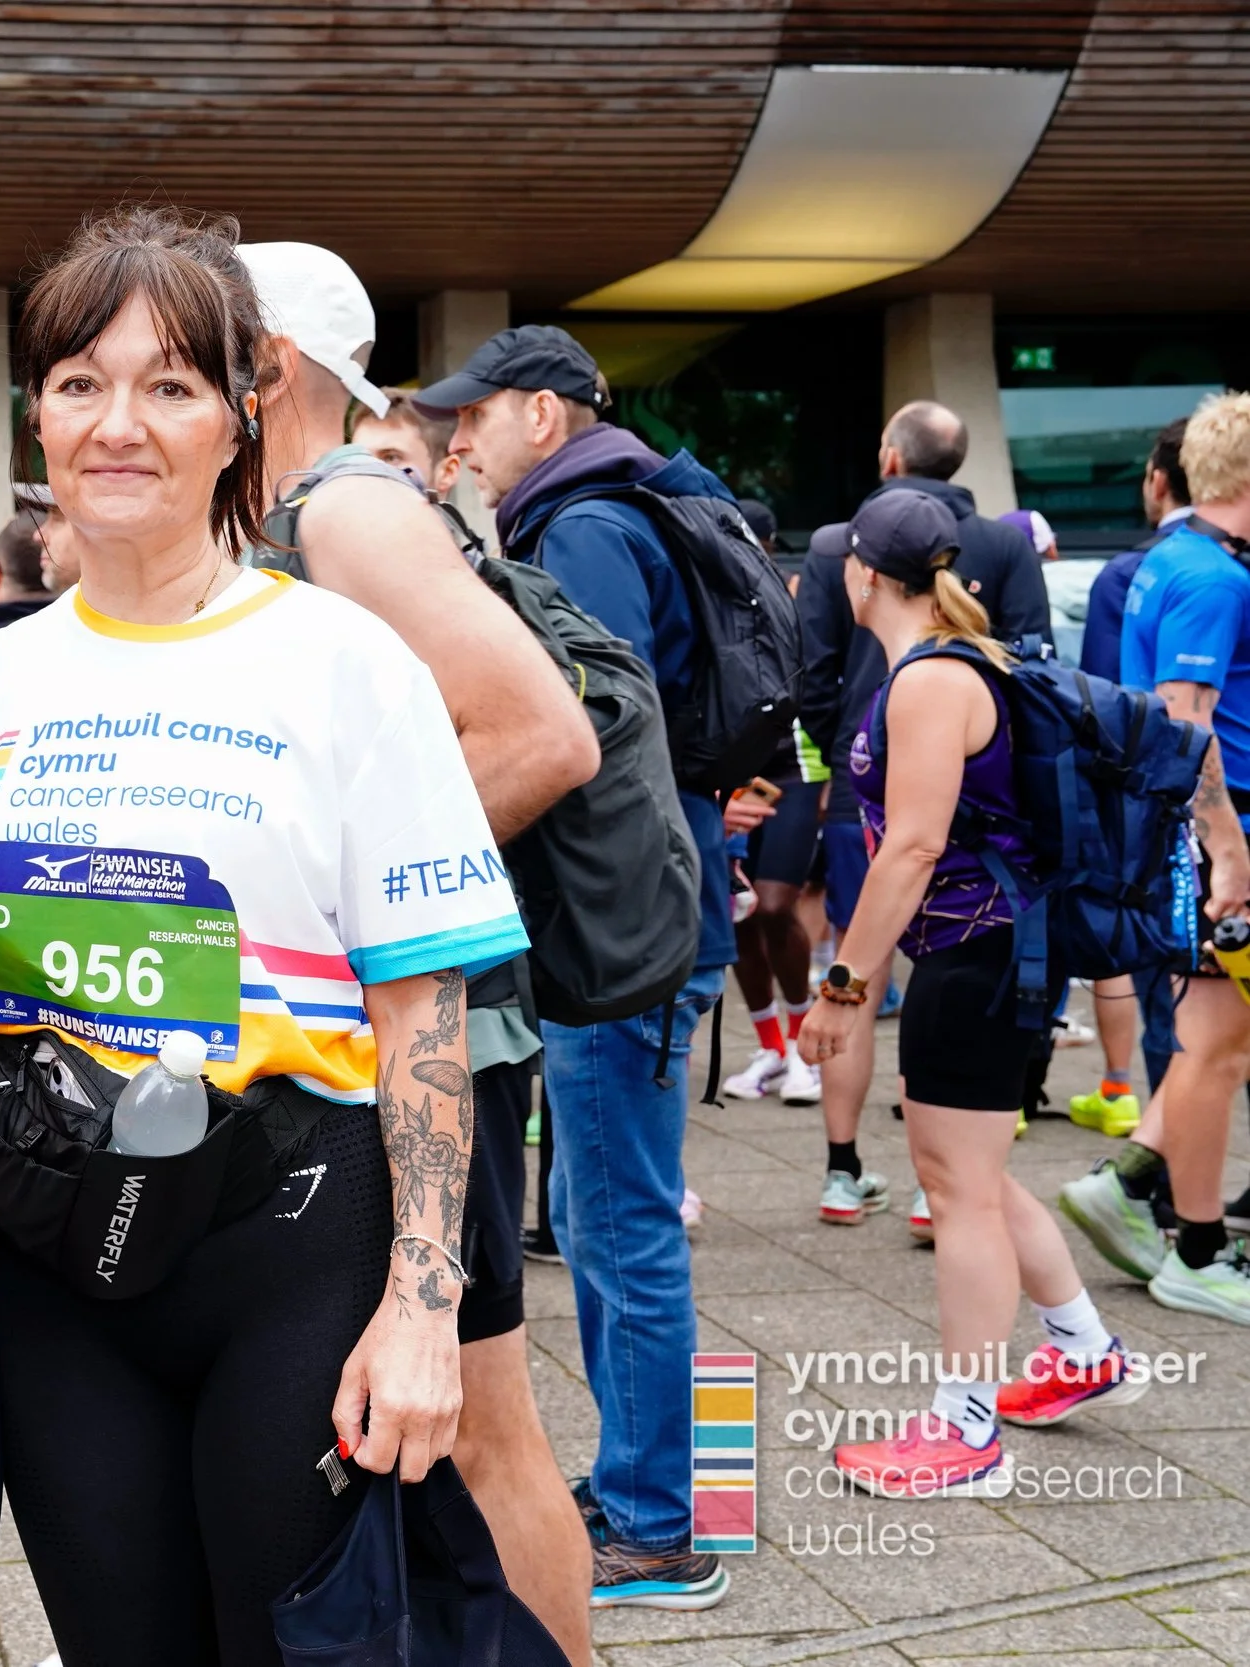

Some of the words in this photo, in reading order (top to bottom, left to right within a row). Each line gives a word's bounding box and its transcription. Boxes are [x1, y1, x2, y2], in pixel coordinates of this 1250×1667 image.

[28, 712, 161, 748] ymchwil
[167, 720, 288, 761] canser
[19, 753, 117, 779] cymru
[9, 786, 117, 807] cancer
[119, 785, 263, 824] research
[6, 816, 98, 845] wales
[95, 854, 185, 878] SWANSEA
[118, 890, 153, 898] MARATHON
[149, 931, 202, 946] RESEARCH
[203, 935, 237, 948] WALES
[196, 919, 236, 933] CANCER
[41, 940, 165, 1007] 956
[37, 1008, 171, 1049] #RUNSWANSE
[96, 1175, 147, 1283] WATERFLY
